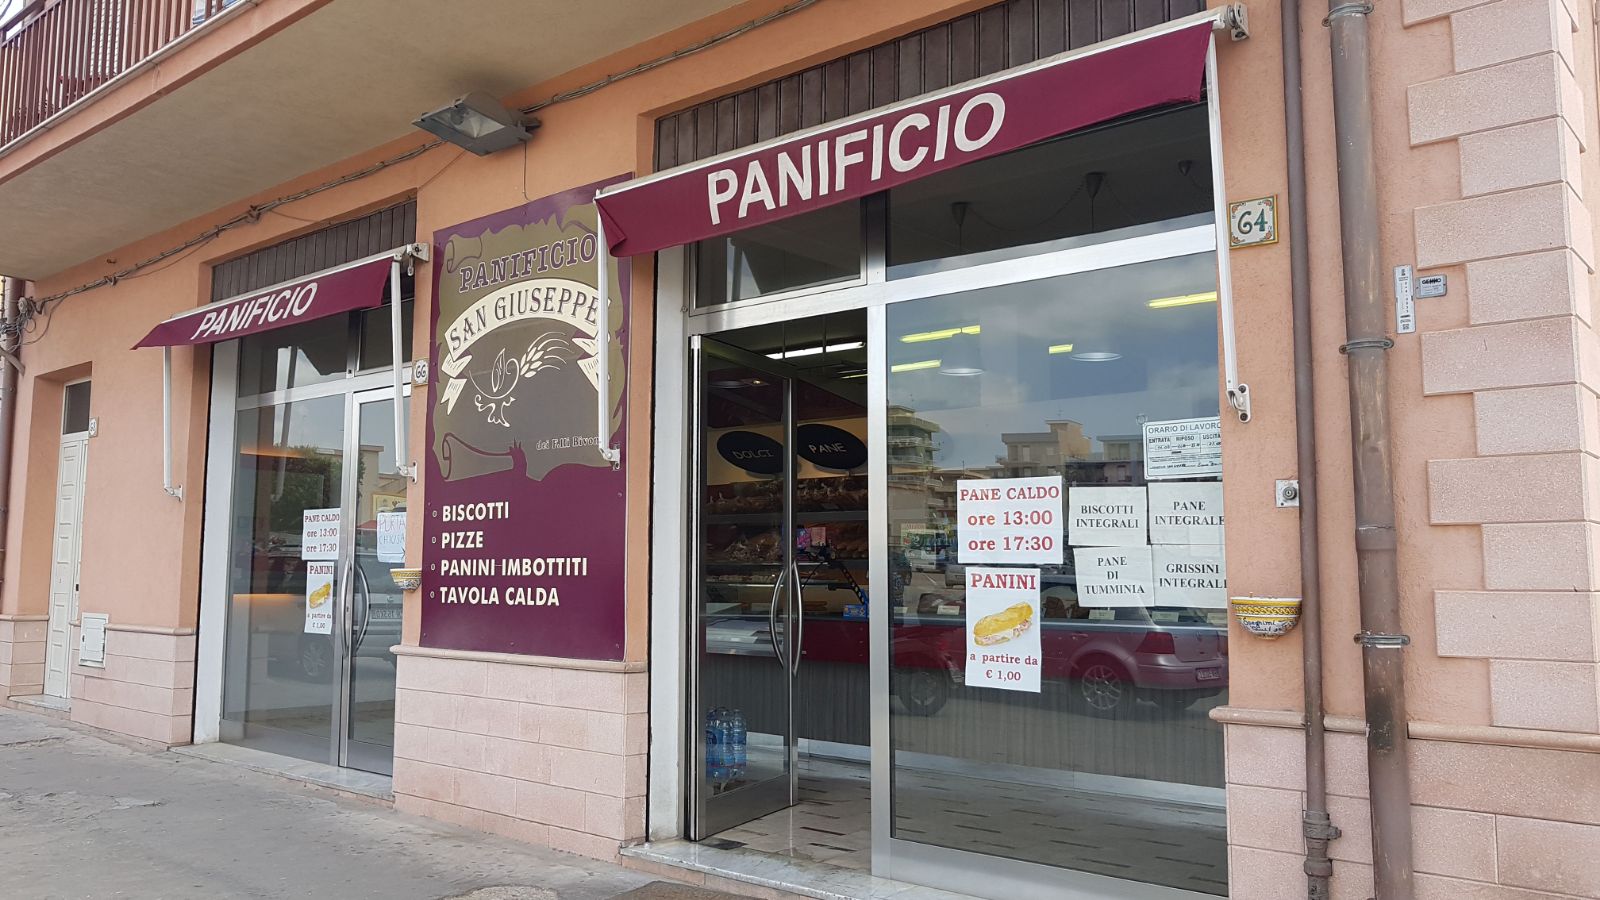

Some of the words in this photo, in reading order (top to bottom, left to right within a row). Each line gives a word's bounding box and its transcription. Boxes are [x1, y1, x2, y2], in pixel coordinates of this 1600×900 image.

[708, 92, 1006, 225] PANIFICIO
[1237, 208, 1268, 235] 64
[458, 233, 598, 293] PANIFICIO
[190, 282, 318, 340] PANIFICIO
[449, 305, 487, 352] SAN
[494, 287, 598, 326] GIUSEPPE
[1148, 425, 1178, 434] ORARIO
[1180, 424, 1188, 432] DI
[808, 442, 847, 454] PANE
[959, 488, 1002, 501] PANE
[1006, 486, 1060, 500] CALDO
[442, 501, 509, 522] BISCOTTI
[1080, 505, 1134, 514] BISCOTTI
[1173, 501, 1206, 511] PANE
[304, 514, 320, 522] PANE
[321, 513, 340, 521] CALDO
[967, 514, 996, 526] ore
[1003, 510, 1053, 525] 13:00
[1076, 518, 1139, 528] INTEGRALI
[1155, 515, 1225, 526] INTEGRALE
[307, 529, 317, 537] ore
[319, 528, 337, 537] 13:00
[441, 531, 484, 549] PIZZE
[968, 539, 996, 551] ore
[1003, 536, 1053, 551] 17:30
[306, 544, 317, 552] ore
[319, 543, 337, 552] 17:30
[440, 558, 496, 576] PANINI
[502, 557, 588, 576] IMBOTTITI
[1097, 556, 1128, 566] PANE
[309, 565, 333, 574] PANINI
[1107, 570, 1119, 580] DI
[1166, 563, 1219, 574] GRISSINI
[970, 573, 1037, 590] PANINI
[1084, 584, 1145, 594] TUMMINIA
[440, 586, 500, 605] TAVOLA
[505, 587, 560, 606] CALDA
[969, 653, 976, 661] a
[981, 653, 1021, 664] partire
[1024, 655, 1038, 666] da
[986, 669, 993, 679] €
[997, 670, 1021, 682] 1,00
